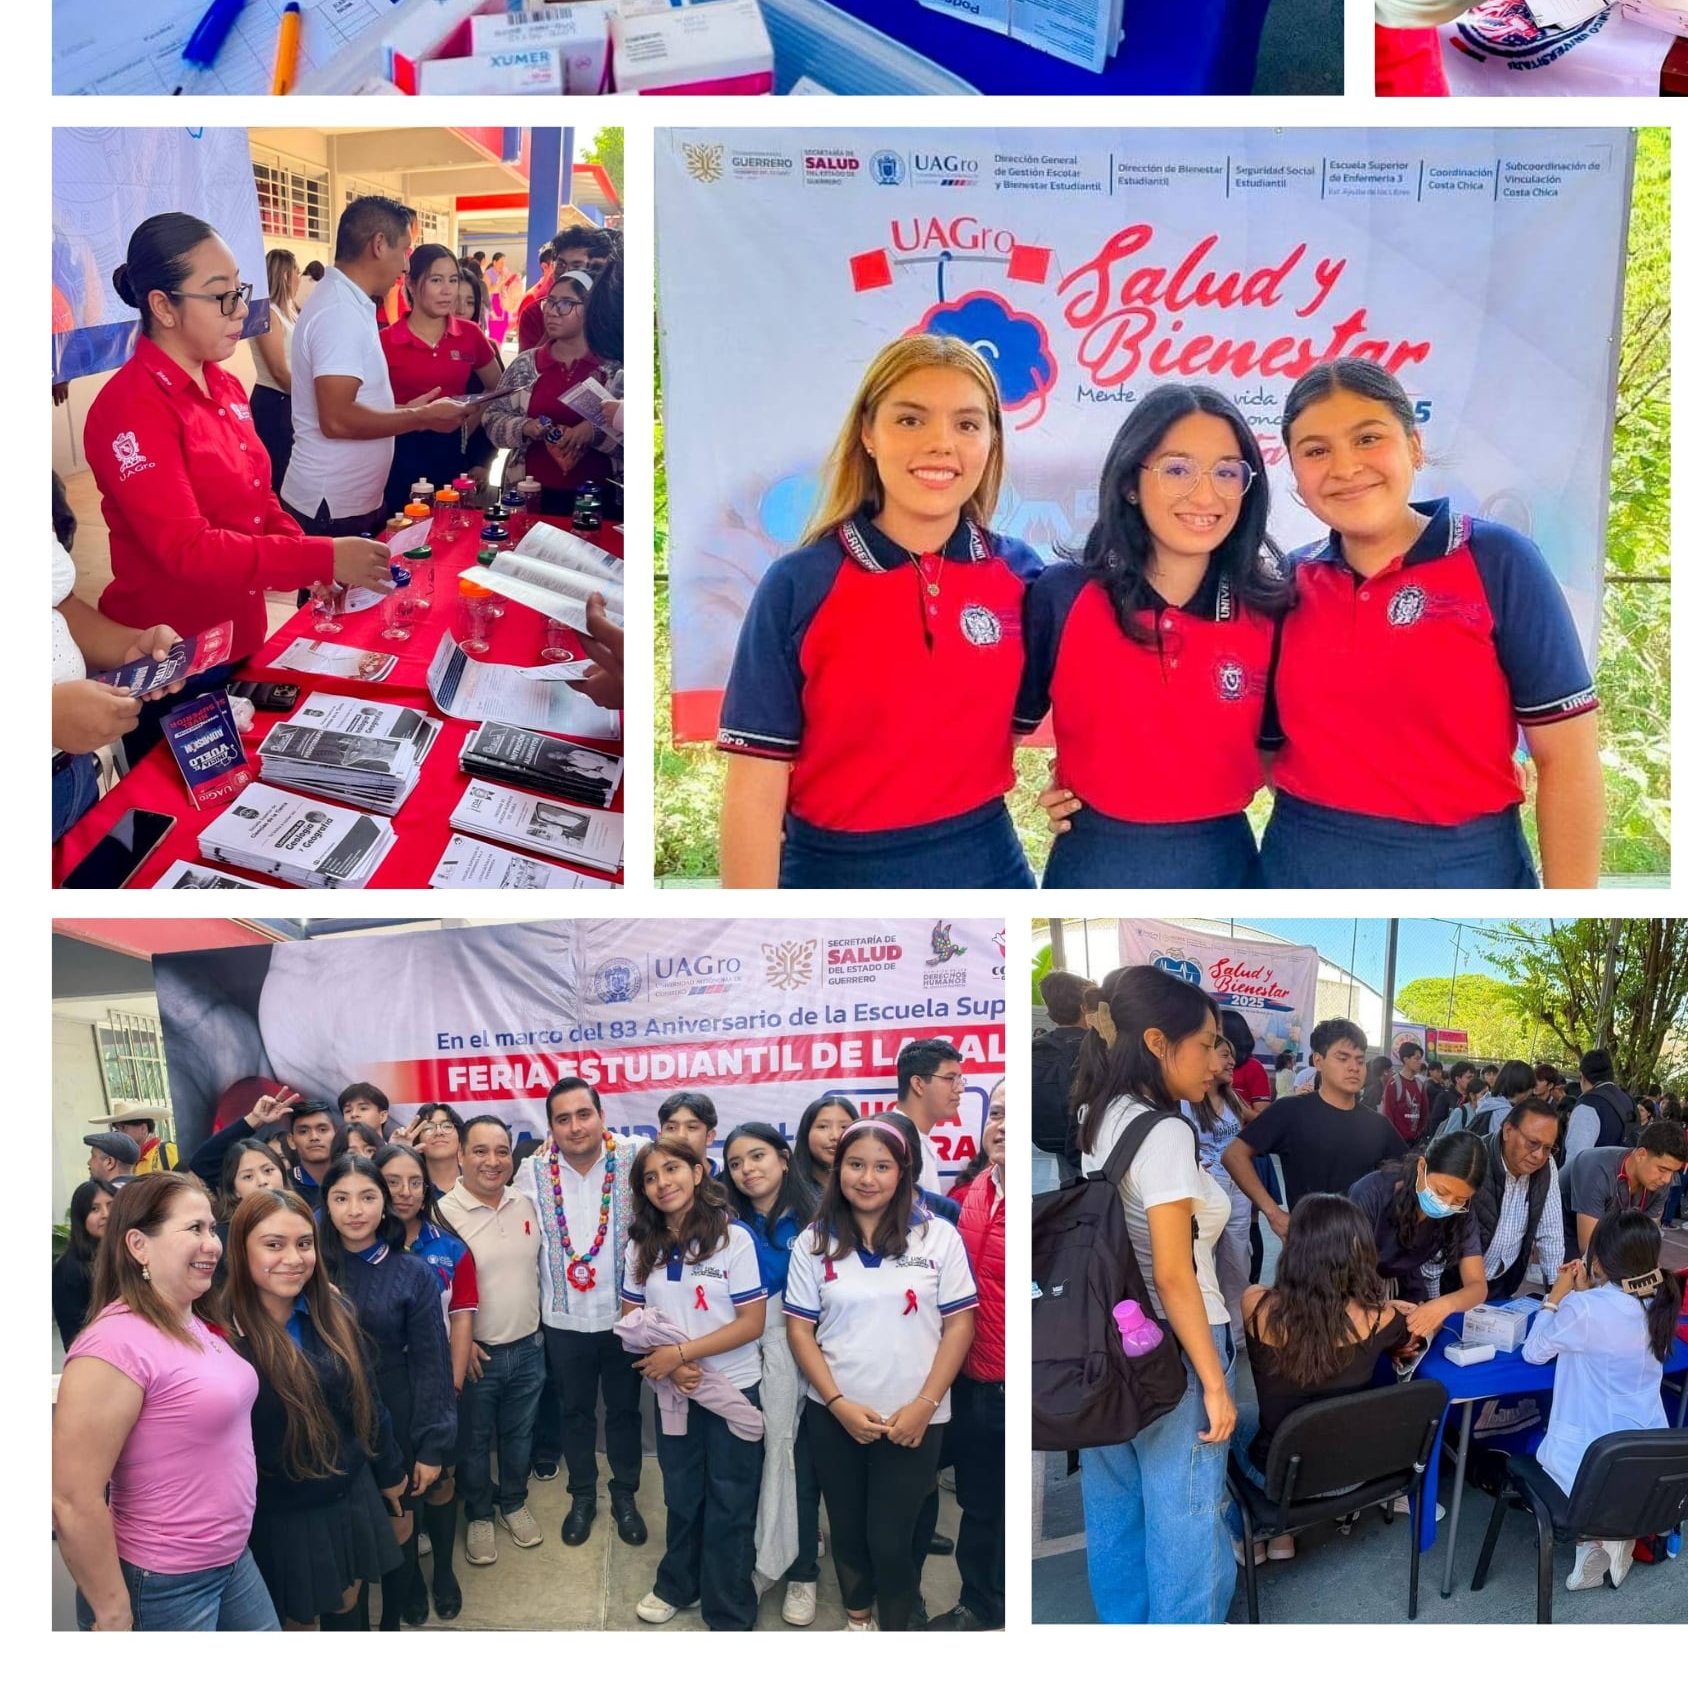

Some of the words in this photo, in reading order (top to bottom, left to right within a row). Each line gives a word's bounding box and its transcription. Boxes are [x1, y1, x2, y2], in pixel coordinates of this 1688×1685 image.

[490, 51, 550, 67] XUMER
[732, 157, 792, 169] GUERRERO
[805, 157, 859, 170] SALUD
[914, 154, 979, 172] UAGro
[994, 154, 1039, 165] Dirección
[1041, 155, 1077, 165] General
[1330, 160, 1366, 169] Escuela
[1368, 161, 1408, 171] Superior
[1118, 163, 1163, 173] Dirección
[1165, 164, 1176, 173] de
[1178, 165, 1223, 175] Bienestar
[1236, 166, 1284, 176] Seguridad
[1286, 166, 1315, 176] Social
[1505, 162, 1586, 171] Subcoordinación
[1588, 163, 1600, 171] de
[994, 168, 1007, 176] de
[1008, 168, 1044, 178] Gestión
[1047, 169, 1081, 178] Escolar
[1329, 173, 1341, 182] de
[1429, 168, 1493, 178] Coordinación
[1118, 176, 1169, 186] Estudiantil
[1235, 178, 1287, 188] Estudiantil
[1428, 181, 1455, 189] Costa
[1457, 181, 1483, 190] Chica
[1505, 175, 1561, 184] Vinculación
[1003, 181, 1047, 190] Bienestar
[1050, 181, 1102, 191] Estudiantil
[1503, 188, 1530, 197] Costa
[1532, 188, 1558, 197] Chica
[891, 216, 1015, 253] UAGro
[1057, 223, 1307, 328] Salud
[1295, 258, 1347, 317] y
[1077, 385, 1137, 405] Mente
[1234, 388, 1278, 407] vida
[119, 462, 156, 482] UAGro
[189, 744, 230, 768] VUELO
[286, 823, 315, 851] Geología
[303, 818, 334, 849] Geografía
[828, 937, 882, 948] SECRETARÍA
[884, 935, 896, 944] DE
[828, 945, 902, 964] SALUD
[654, 954, 741, 979] UAGro
[828, 966, 843, 974] DEL
[846, 964, 879, 973] ESTADO
[882, 963, 896, 971] DE
[1208, 958, 1265, 980] Salud
[1265, 969, 1273, 983] y
[828, 975, 876, 985] GUERRERO
[922, 970, 967, 981] DERECHOS
[922, 977, 966, 987] HUMANOS
[1214, 975, 1290, 998] Bienestar
[1231, 995, 1265, 1008] 2025
[437, 1031, 465, 1050] En
[469, 1029, 489, 1049] el
[496, 1031, 563, 1047] marco
[568, 1023, 604, 1043] del
[609, 1020, 638, 1039] 83
[644, 1009, 782, 1037] Aniversario
[788, 1006, 818, 1026] de
[826, 1004, 847, 1024] la
[854, 997, 948, 1022] Escuela
[448, 1061, 550, 1093] FERIA
[557, 1043, 803, 1086] ESTUDIANTIL
[812, 1040, 863, 1070] DE
